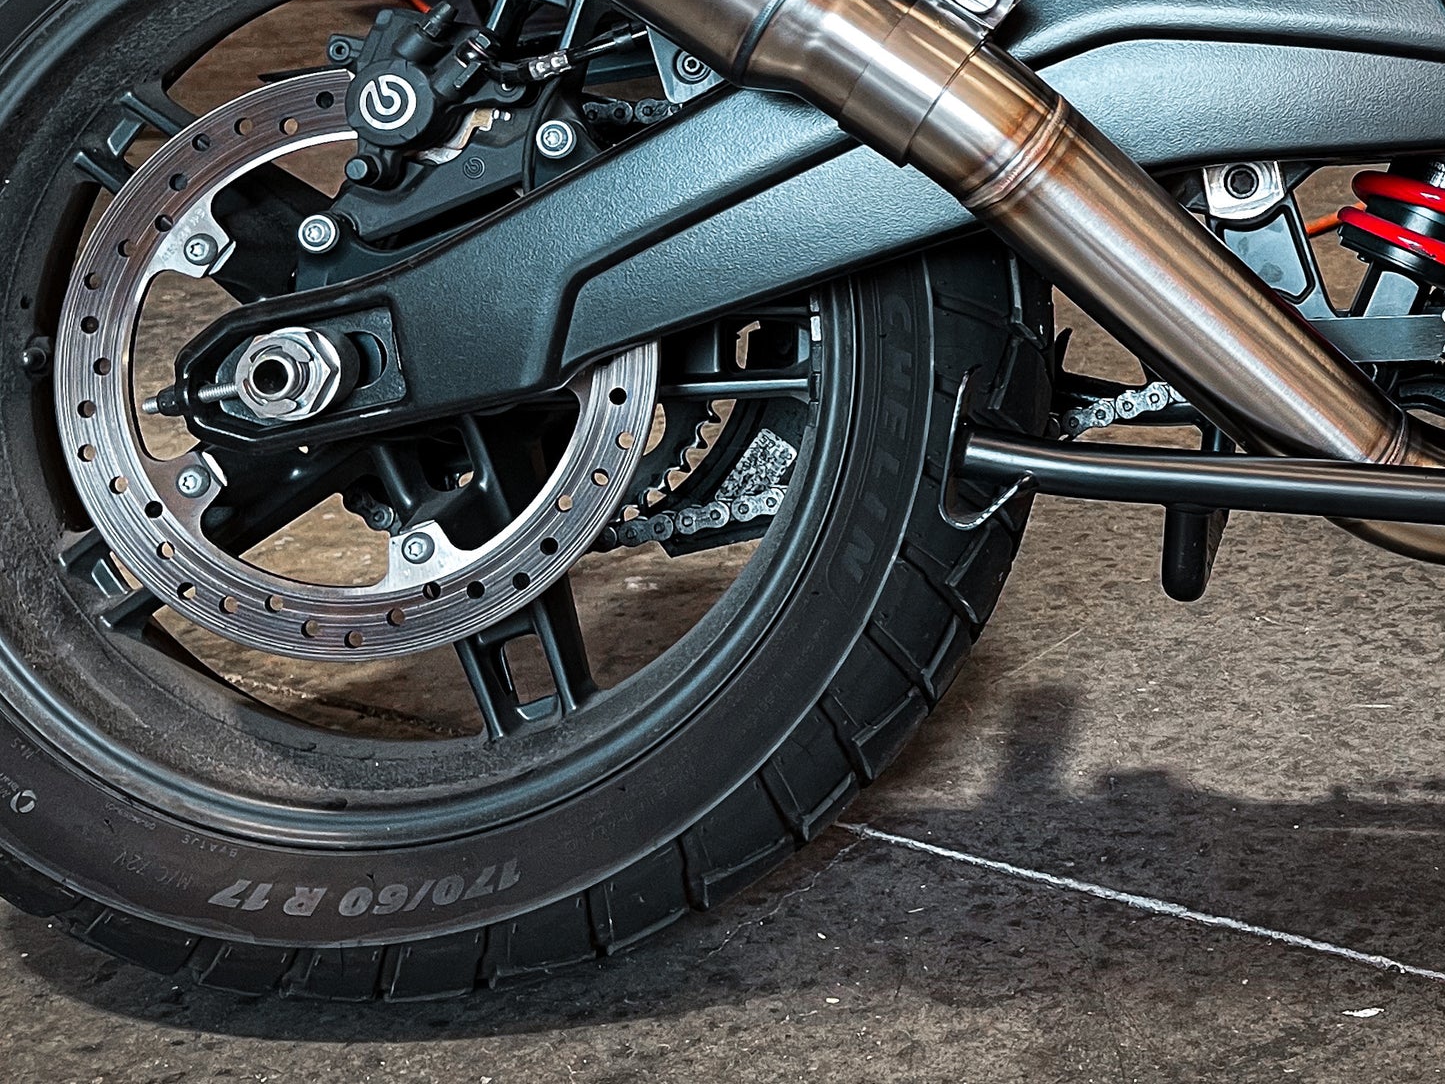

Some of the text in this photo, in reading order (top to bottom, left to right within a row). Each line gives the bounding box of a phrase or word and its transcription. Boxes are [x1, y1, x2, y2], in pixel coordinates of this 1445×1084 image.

[840, 288, 914, 585] CHELIN
[207, 857, 522, 917] 170/60 R 17
